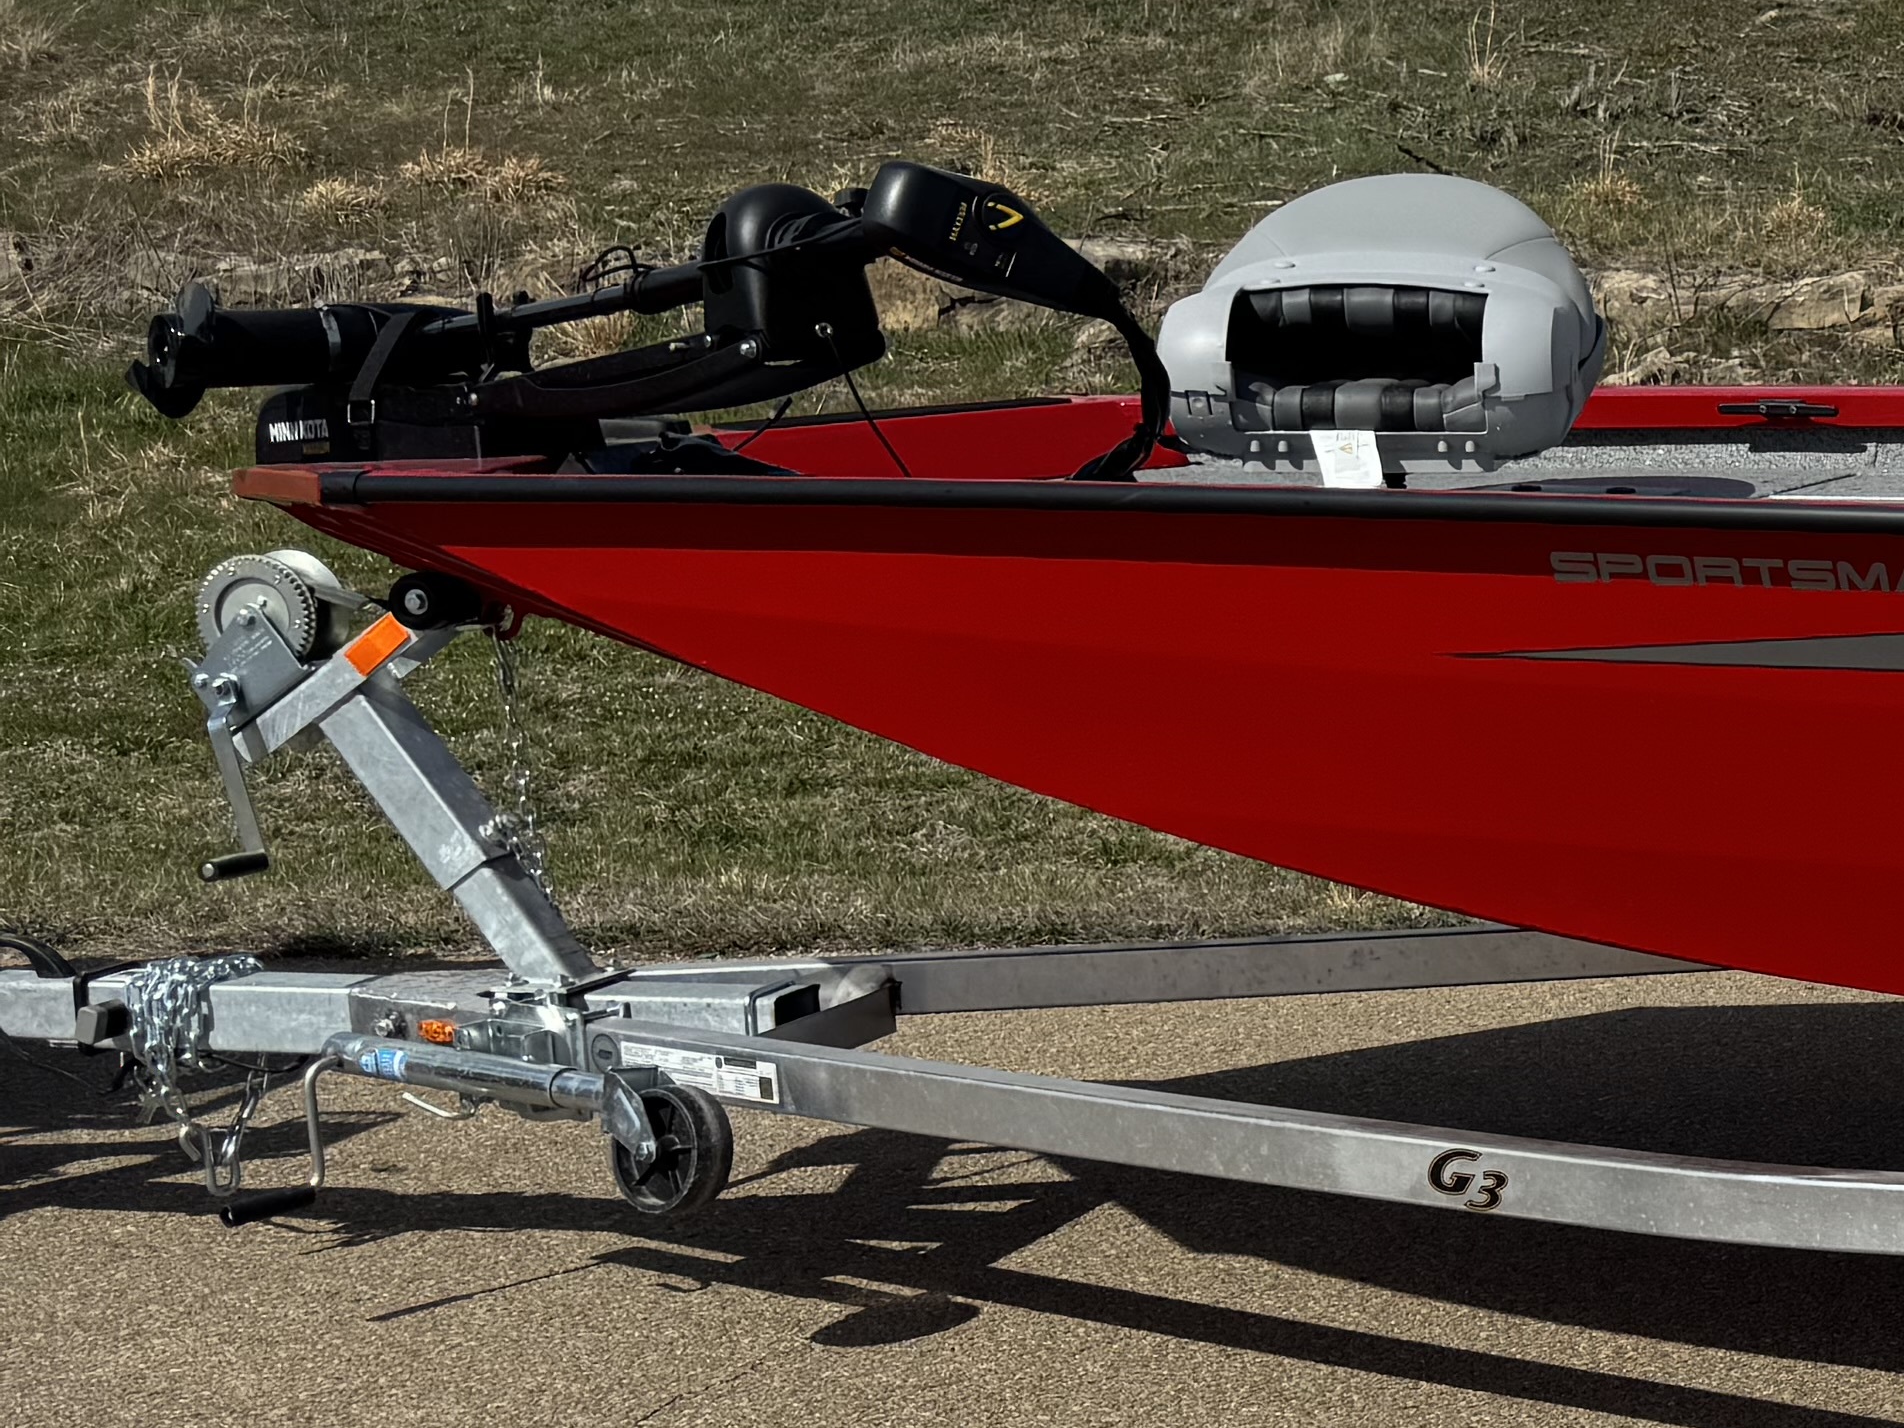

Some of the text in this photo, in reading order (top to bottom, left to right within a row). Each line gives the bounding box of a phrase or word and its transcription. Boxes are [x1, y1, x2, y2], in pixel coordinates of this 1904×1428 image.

[268, 418, 329, 443] MINN KOTA
[1427, 1148, 1509, 1211] G3
